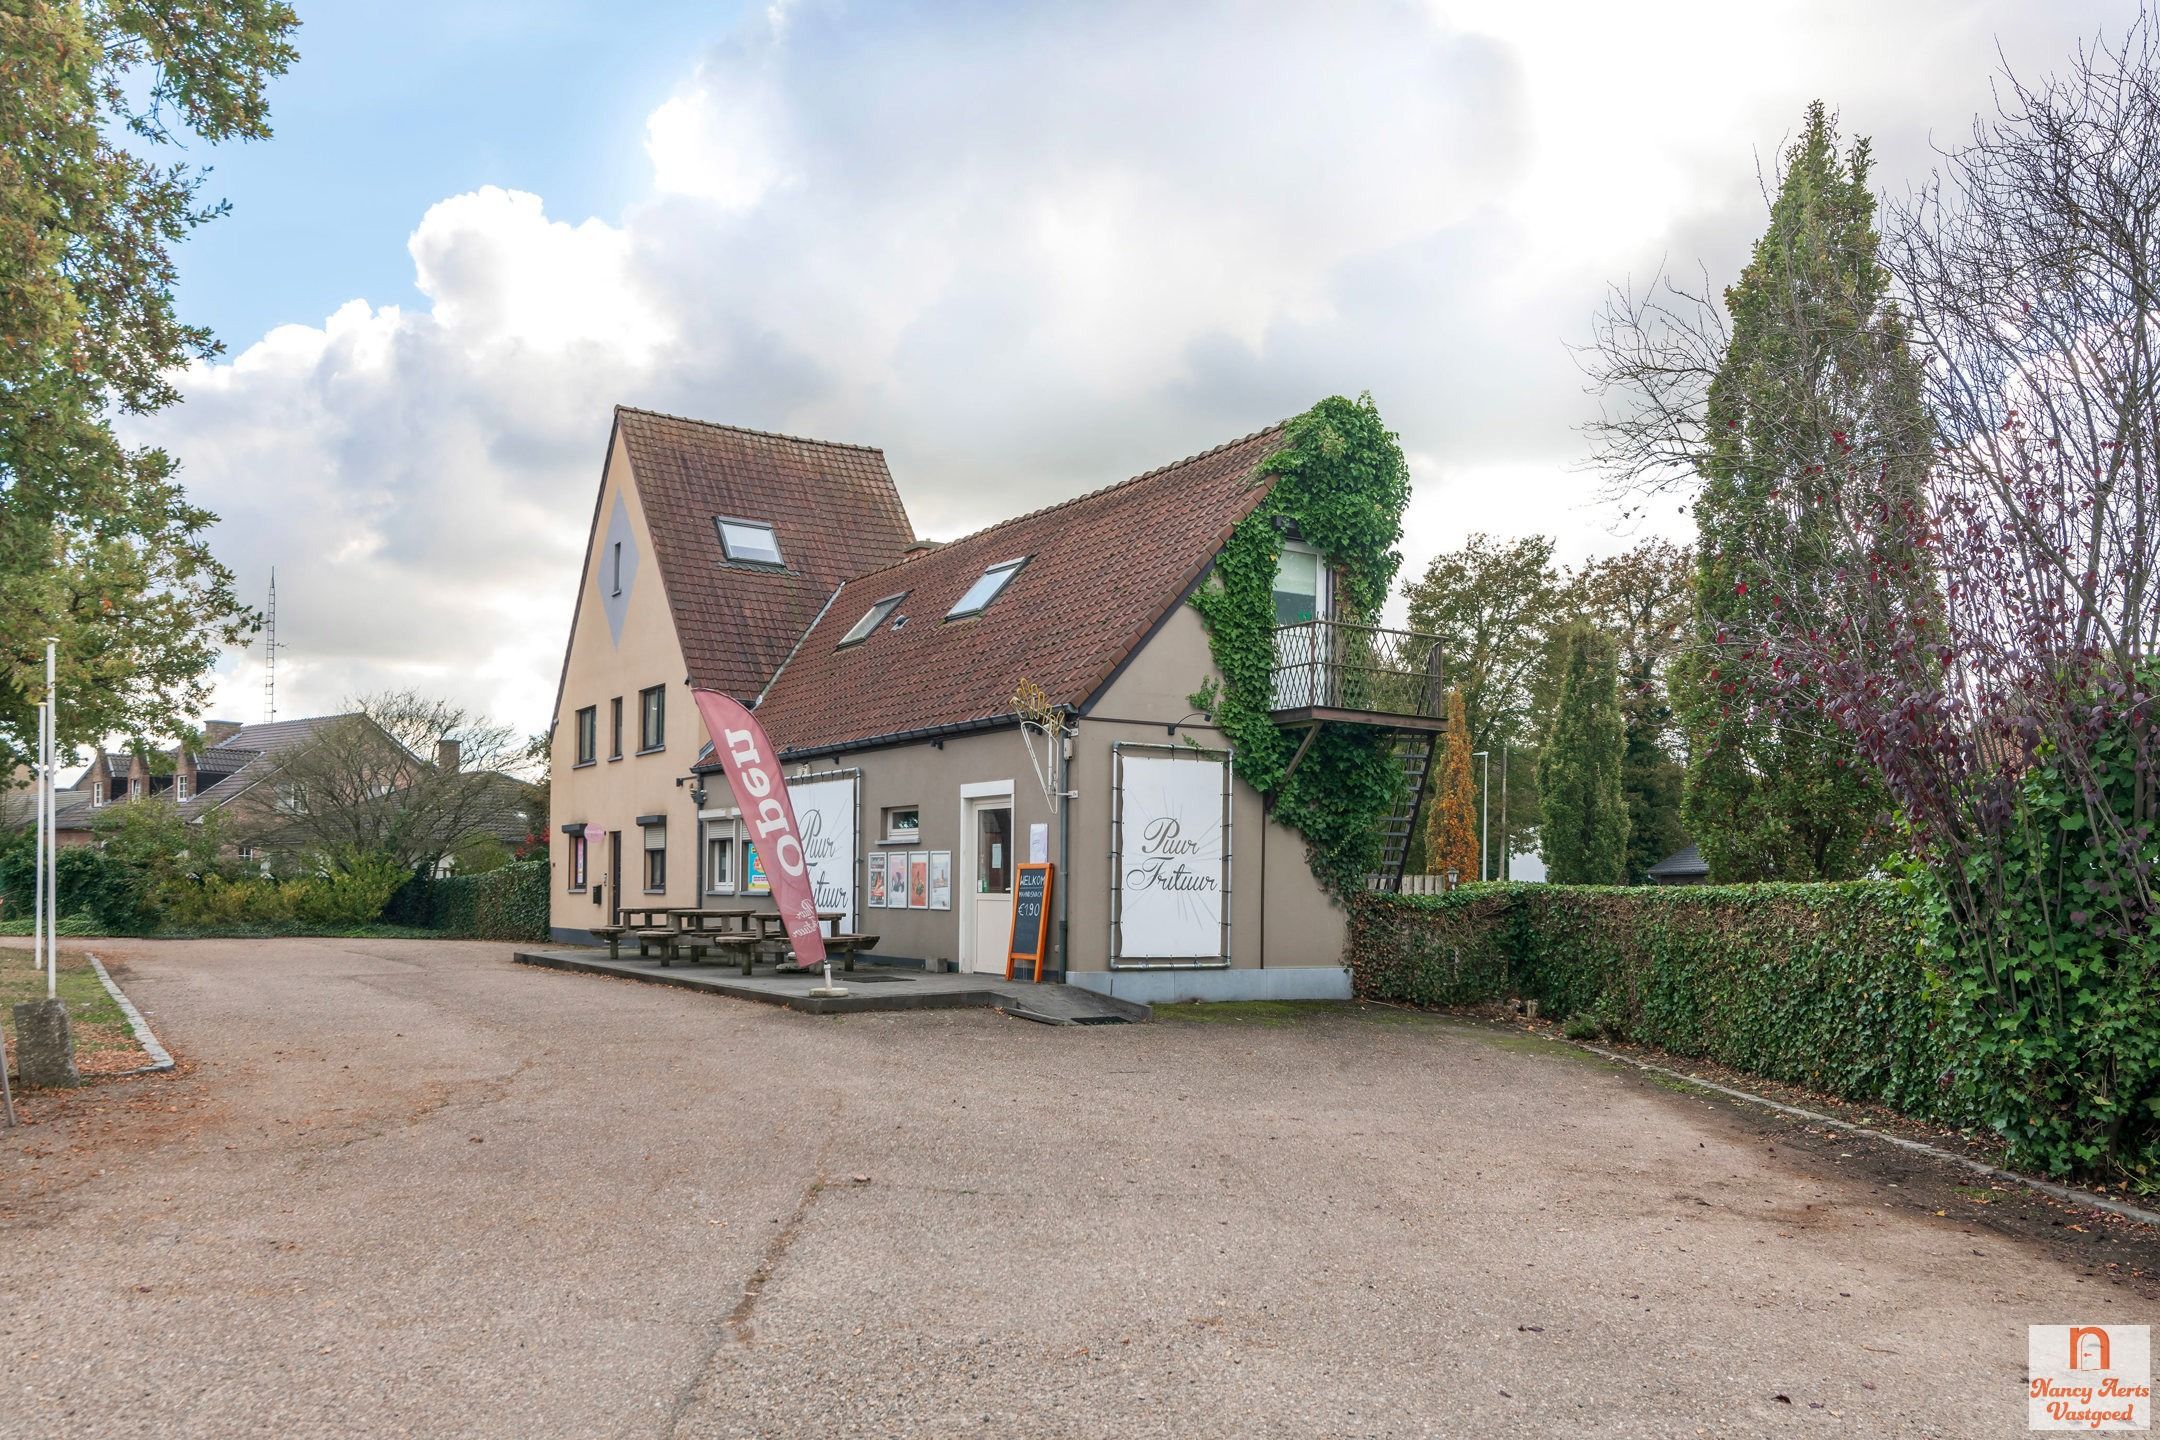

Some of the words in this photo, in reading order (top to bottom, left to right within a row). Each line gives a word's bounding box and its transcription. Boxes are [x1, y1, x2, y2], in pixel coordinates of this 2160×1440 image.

[1141, 816, 1200, 855] Puur
[1020, 875, 1046, 887] WELKOM
[1126, 856, 1218, 892] Frituur
